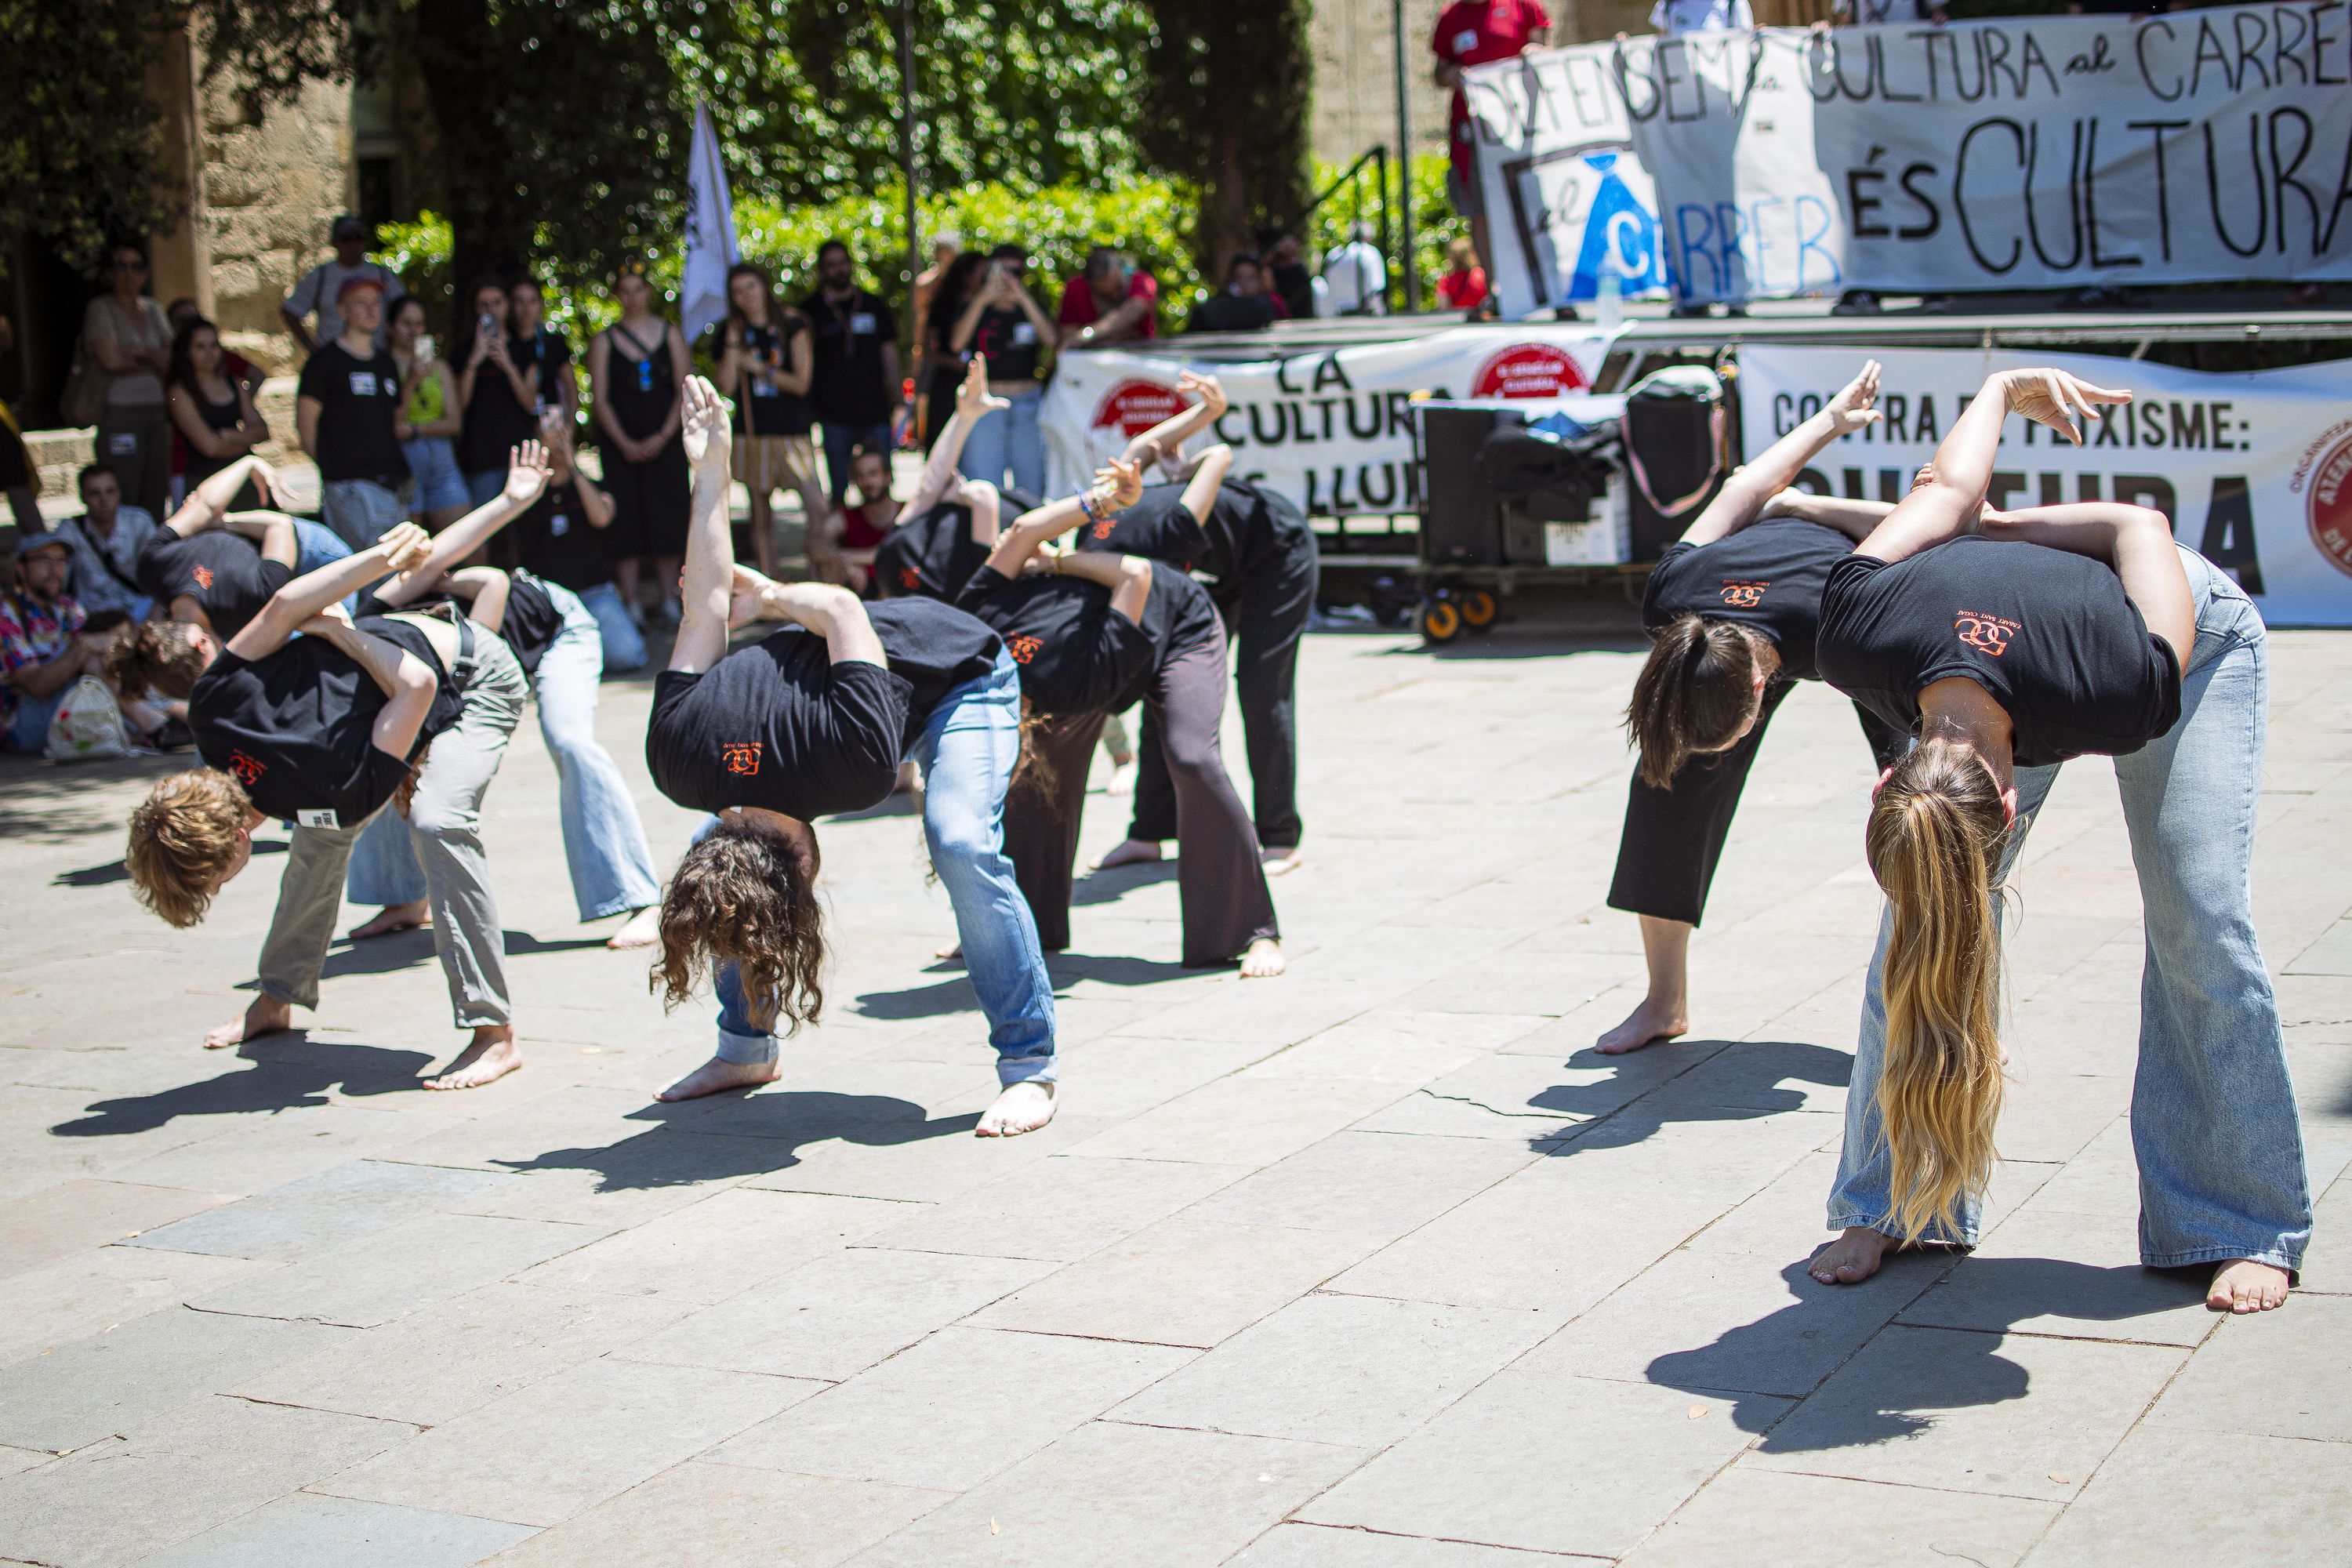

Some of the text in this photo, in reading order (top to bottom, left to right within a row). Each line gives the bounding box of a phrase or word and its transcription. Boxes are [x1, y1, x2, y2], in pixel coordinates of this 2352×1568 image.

[1801, 27, 2060, 103] CULTURA
[2064, 34, 2116, 75] al
[2136, 2, 2352, 103] CARRE
[1847, 147, 1942, 238] ÉS
[1276, 353, 1354, 394] LA
[1213, 387, 1448, 447] CULTUR
[1773, 391, 1940, 444] CORA
